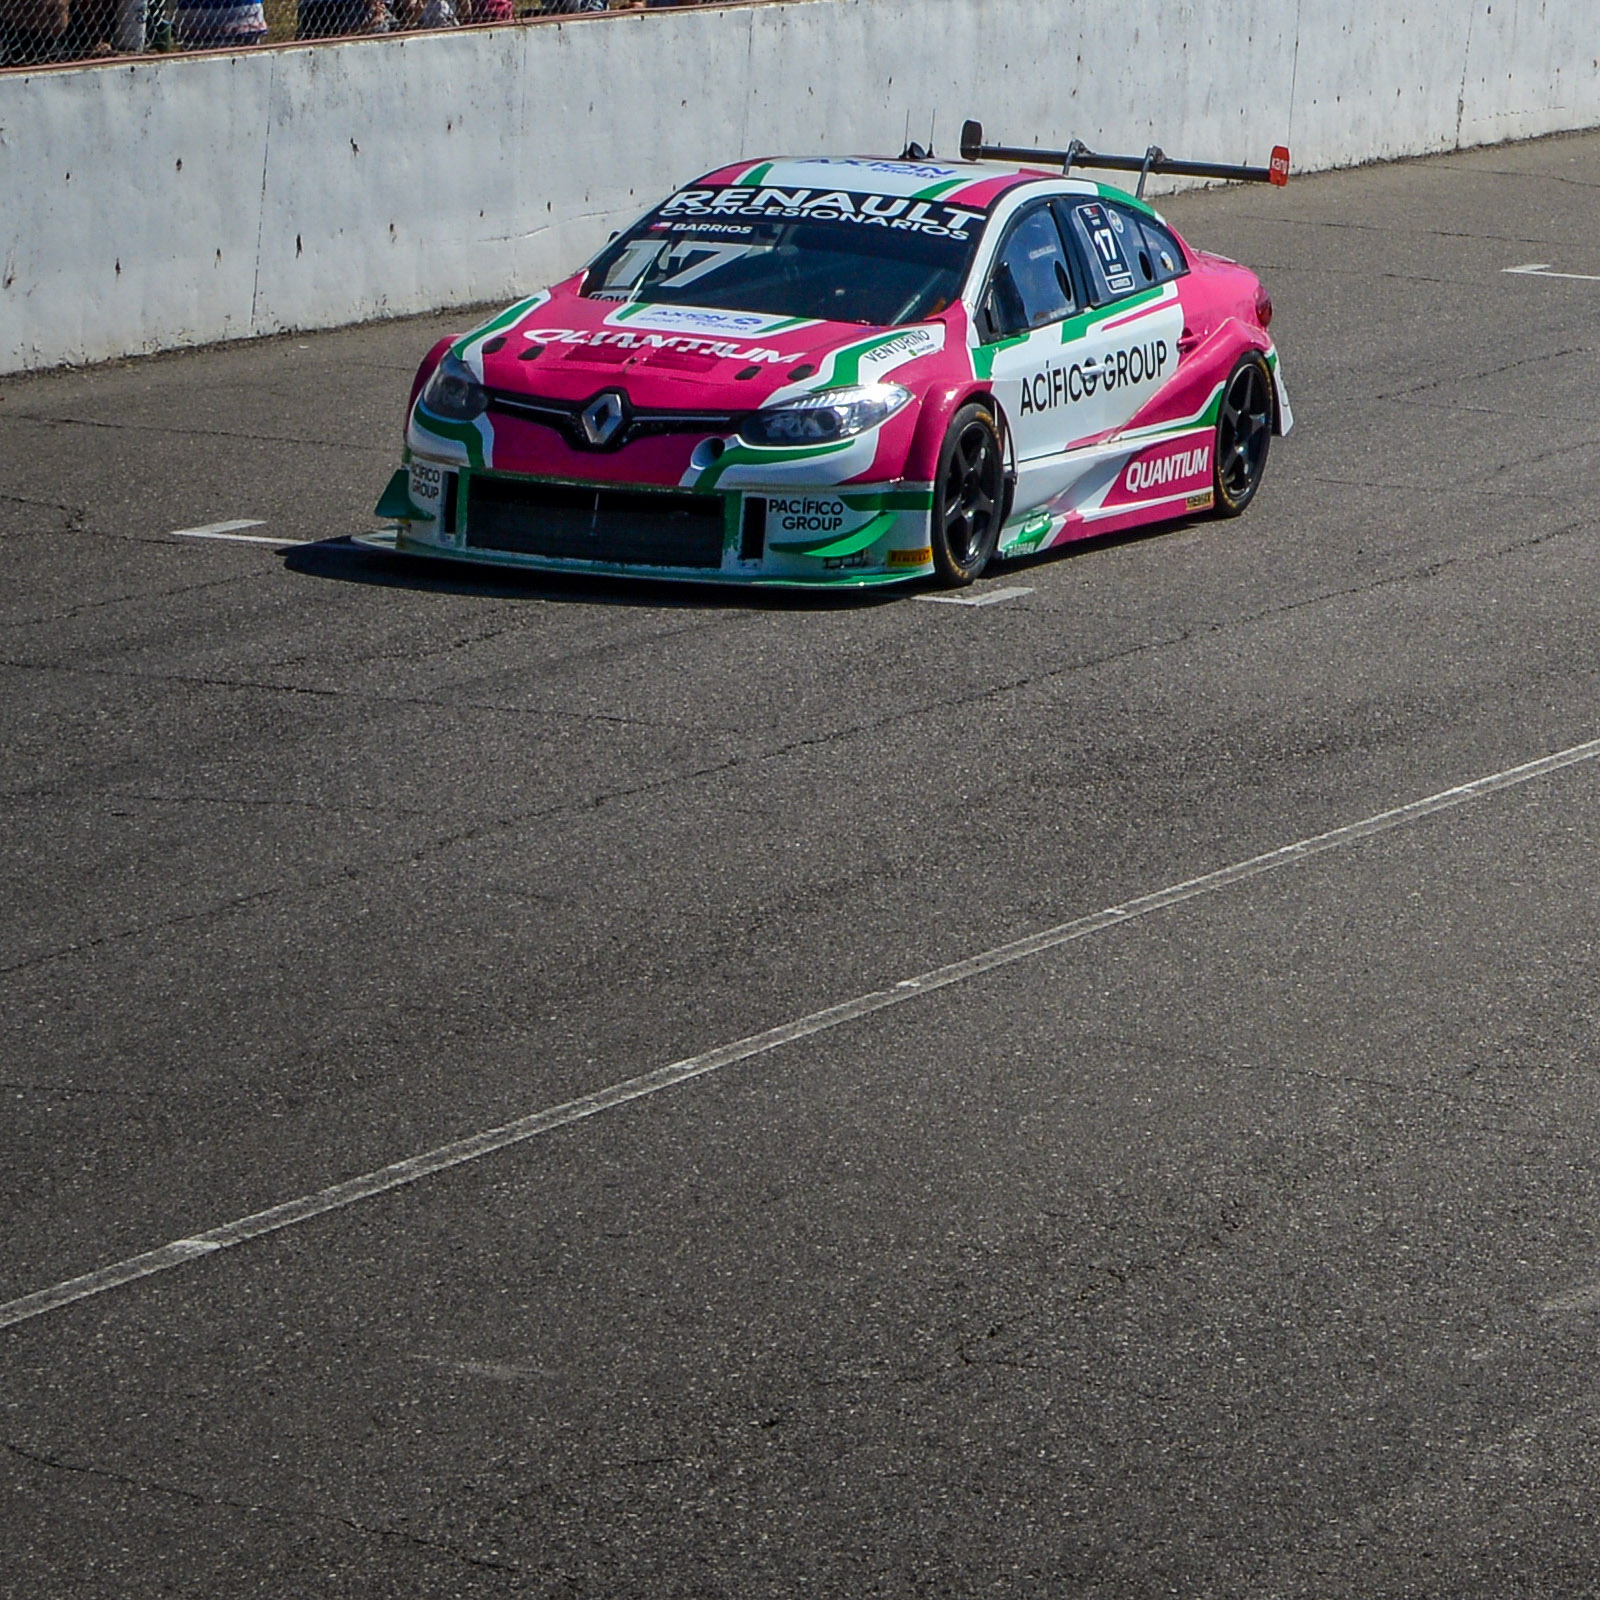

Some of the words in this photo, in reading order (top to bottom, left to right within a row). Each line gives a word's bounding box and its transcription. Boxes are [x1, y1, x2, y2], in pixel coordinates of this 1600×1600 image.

[798, 157, 958, 177] AXION
[870, 166, 941, 180] energy
[657, 206, 970, 241] CONCESIONARIOS
[662, 187, 987, 230] RENAULT
[671, 222, 754, 235] BARRIOS
[1094, 228, 1118, 261] 17
[604, 240, 752, 289] 17
[522, 327, 809, 365] QUANTIUM
[864, 329, 931, 364] VENTURINO
[1101, 339, 1168, 392] GROUP
[1125, 446, 1210, 493] QUANTIUM
[769, 496, 844, 516] PACÍFICO
[782, 515, 844, 532] GROUP
